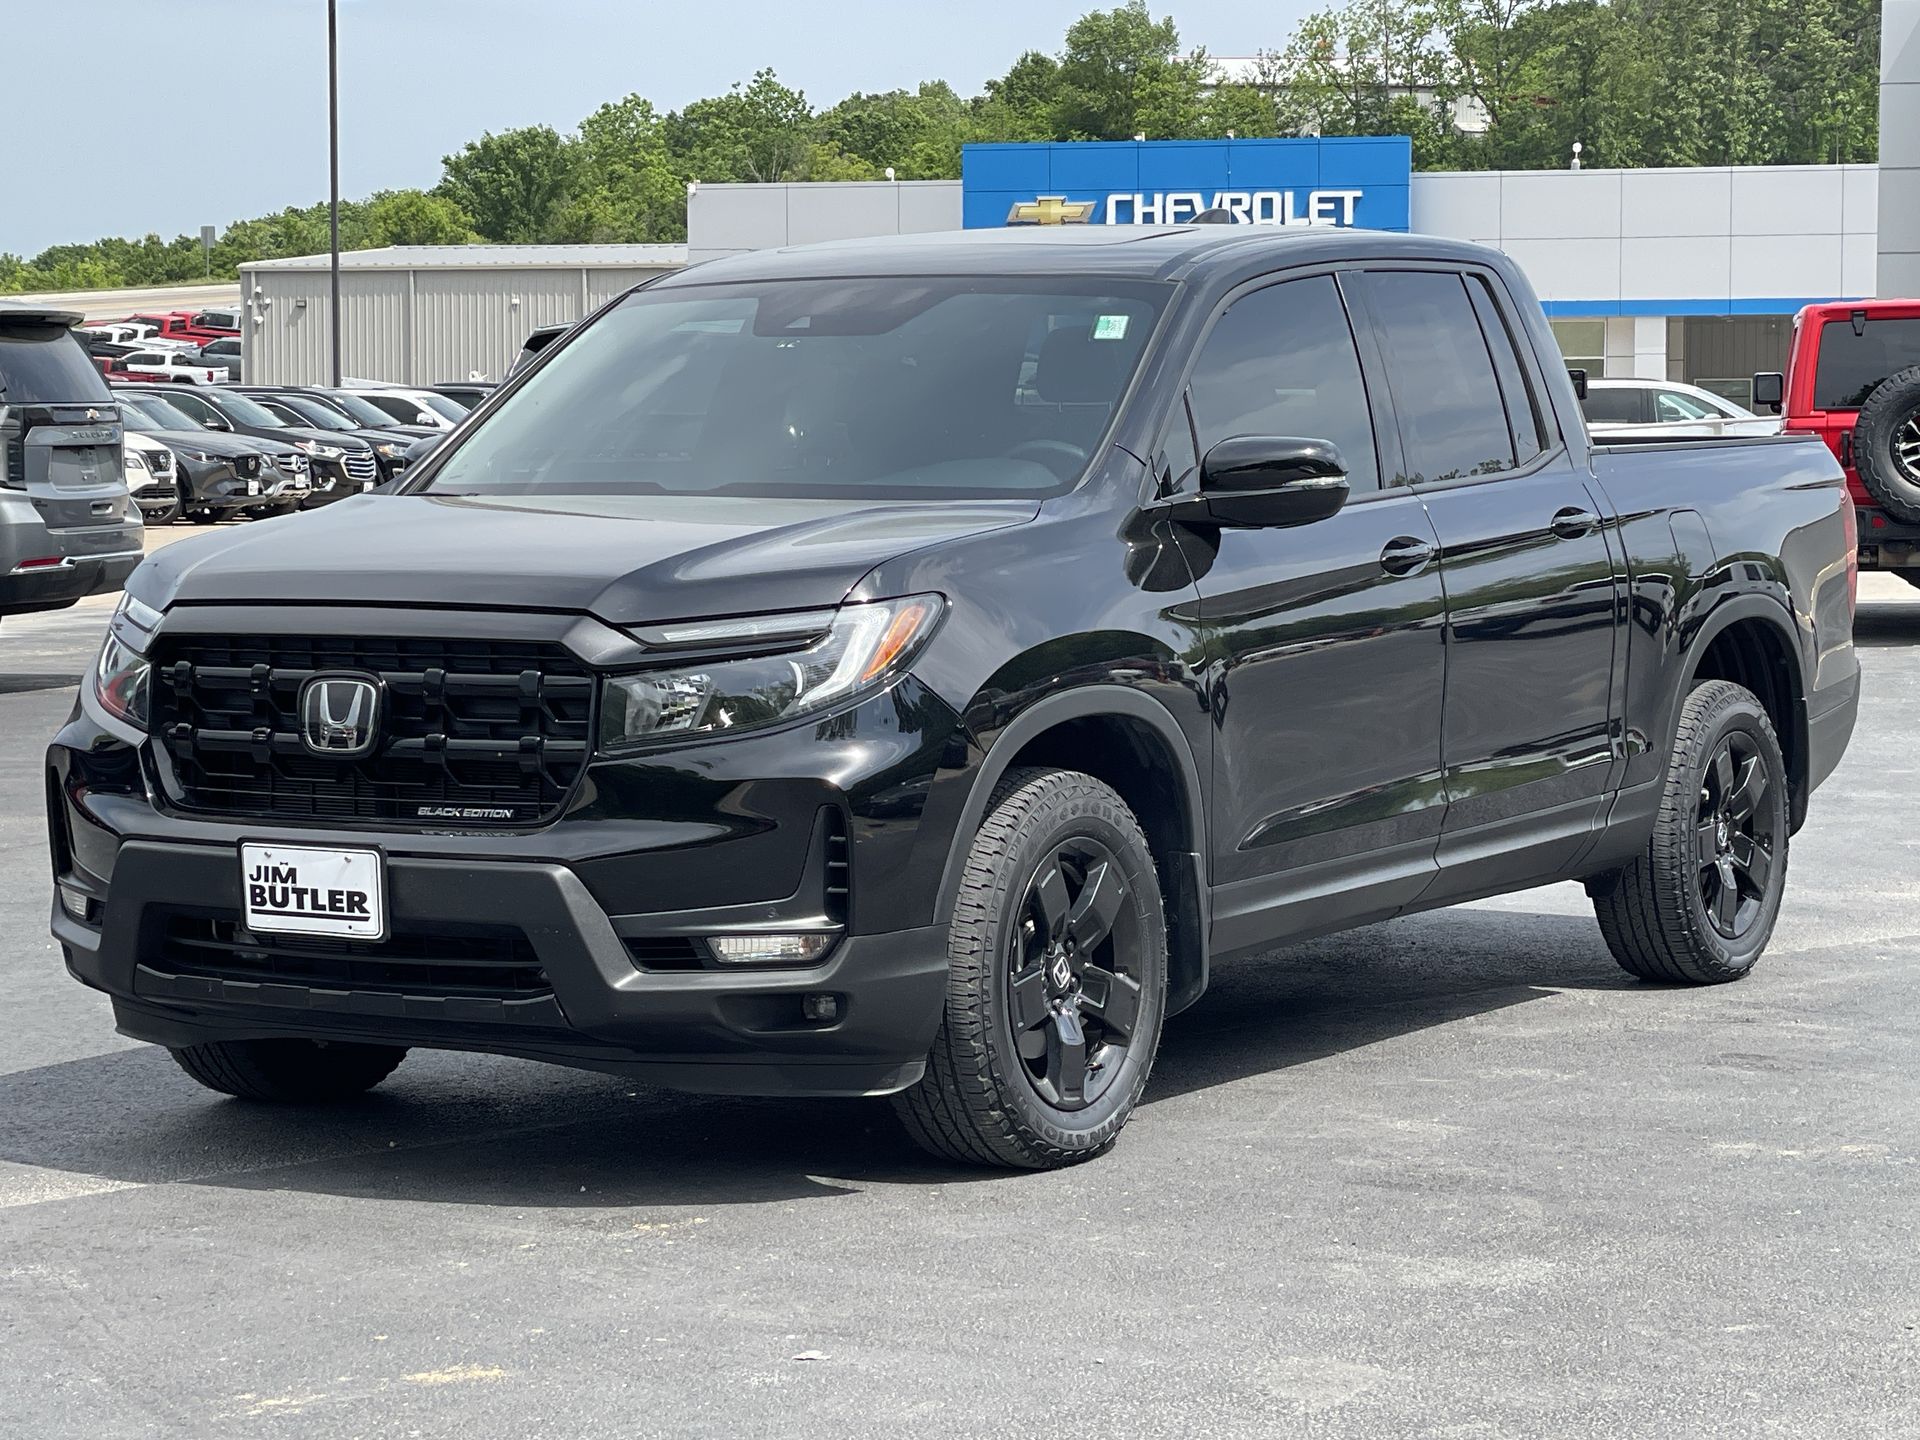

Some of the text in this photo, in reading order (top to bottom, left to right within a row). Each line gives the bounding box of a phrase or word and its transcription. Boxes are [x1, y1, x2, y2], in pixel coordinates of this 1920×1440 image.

[1106, 190, 1363, 226] CHEVROLET
[417, 806, 514, 818] BLACK EDITION
[249, 865, 297, 884] JIM
[249, 884, 371, 914] BUTLER
